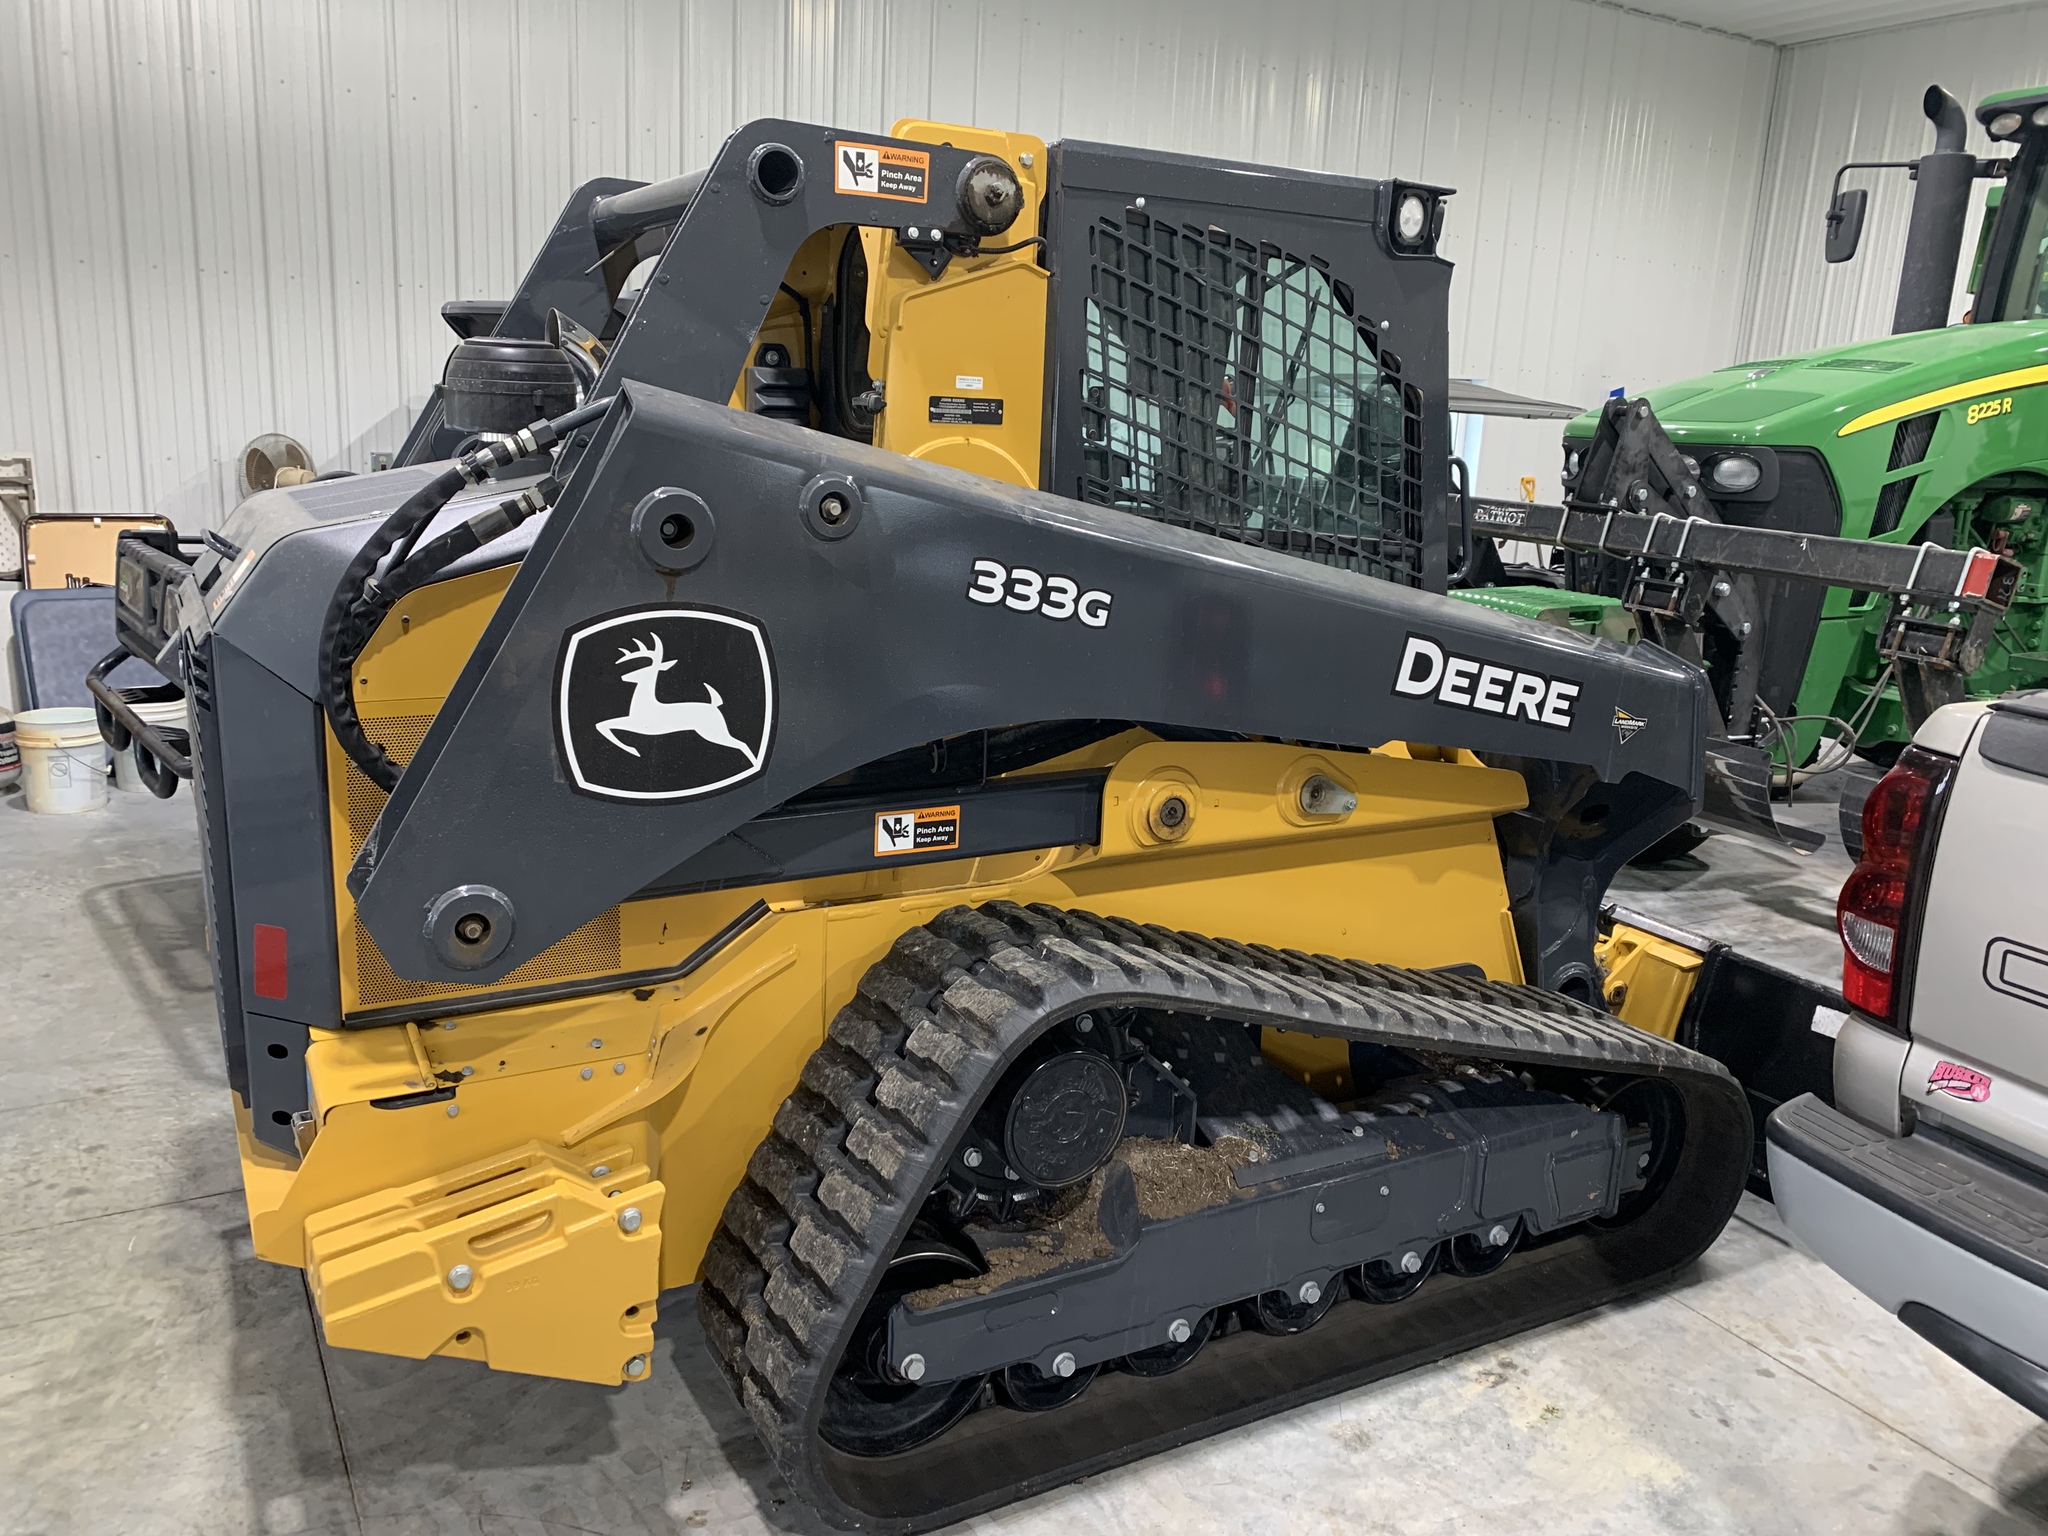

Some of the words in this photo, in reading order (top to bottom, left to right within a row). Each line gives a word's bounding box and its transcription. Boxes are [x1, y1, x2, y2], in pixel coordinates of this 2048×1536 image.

[890, 153, 925, 164] WARNING
[881, 170, 903, 180] Pinch
[904, 173, 922, 182] Area
[881, 180, 898, 190] Keep
[898, 183, 916, 193] Away
[1473, 508, 1526, 525] PATRIOT
[967, 560, 1112, 627] 333G
[1394, 636, 1580, 727] DEERE
[924, 809, 956, 819] WARNING
[916, 826, 936, 835] Pinch
[937, 825, 954, 833] Area
